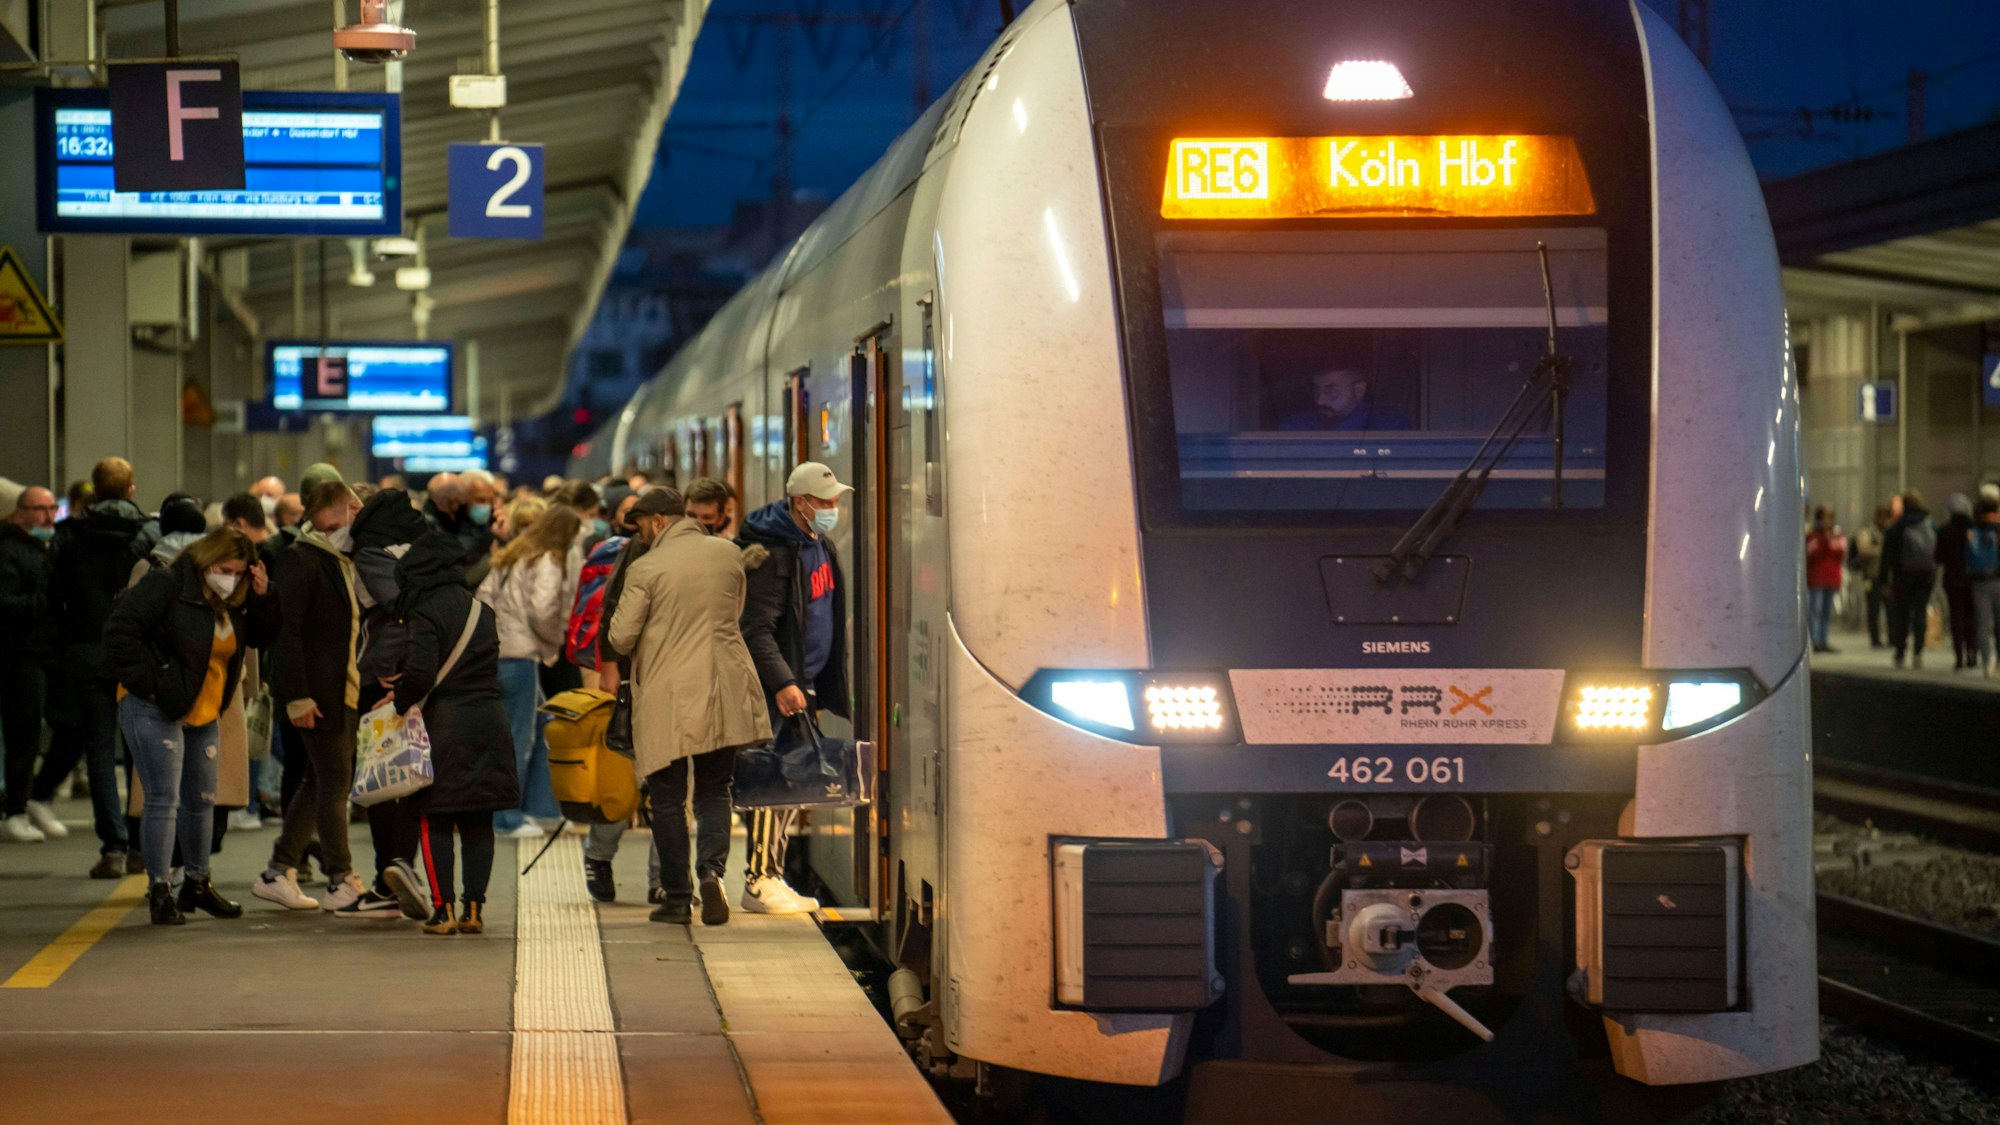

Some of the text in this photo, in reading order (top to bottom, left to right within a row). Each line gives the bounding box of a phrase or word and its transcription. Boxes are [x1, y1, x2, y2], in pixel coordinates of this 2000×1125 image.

[166, 69, 221, 161] F
[485, 147, 532, 218] 2
[1181, 140, 1517, 194] RE6 Köln Hbf
[317, 356, 343, 396] E
[1362, 641, 1431, 654] SIEMENS
[1351, 684, 1494, 716] RRX
[1400, 718, 1528, 729] RHEIN RUHR XPRESS
[1327, 757, 1465, 783] 462 061
